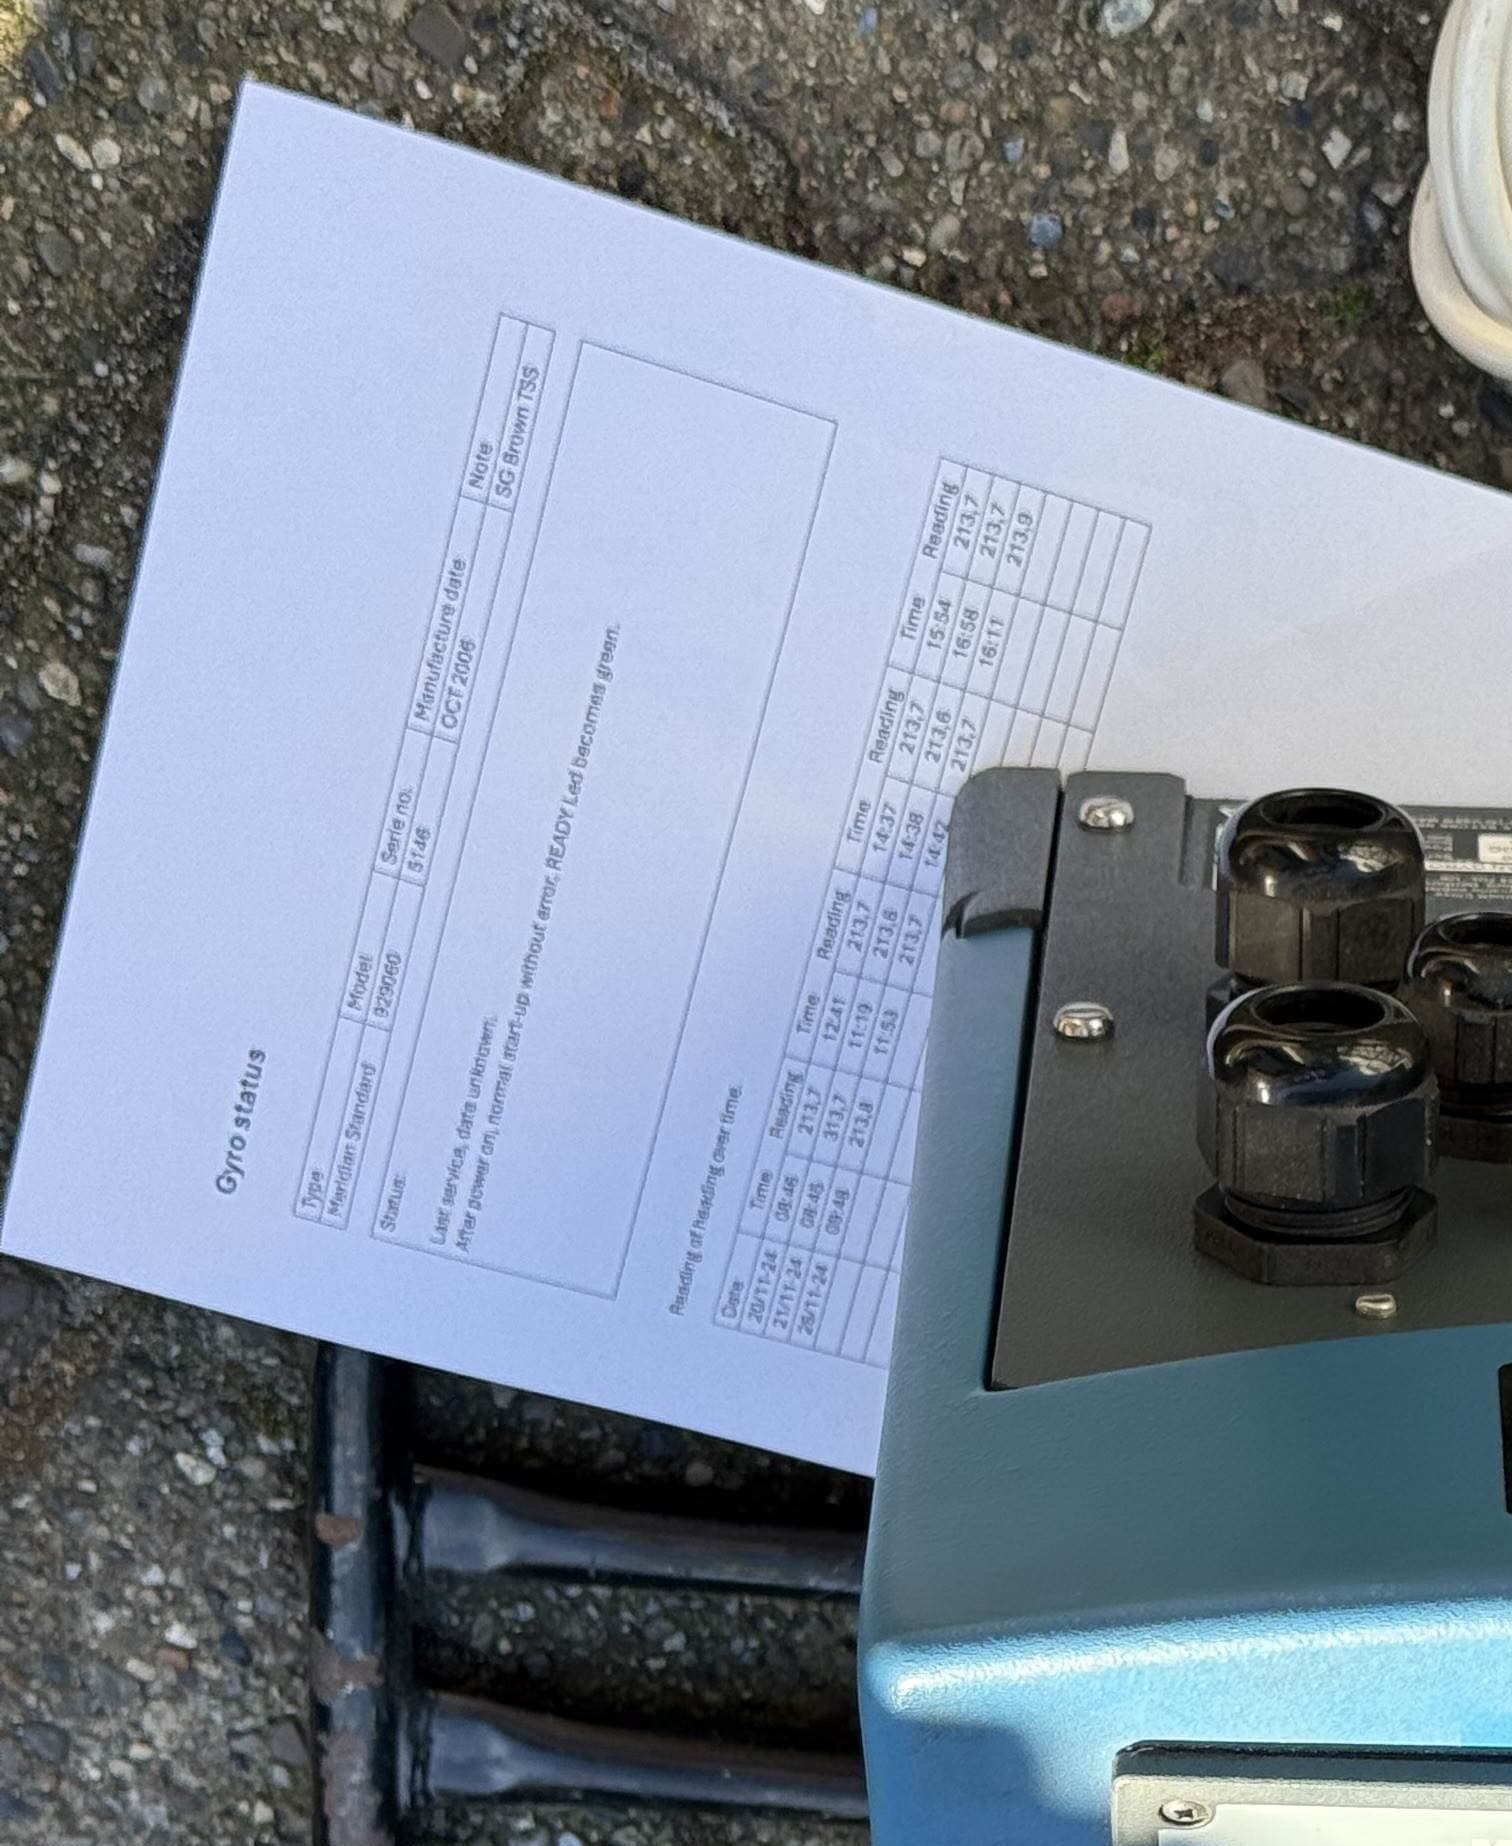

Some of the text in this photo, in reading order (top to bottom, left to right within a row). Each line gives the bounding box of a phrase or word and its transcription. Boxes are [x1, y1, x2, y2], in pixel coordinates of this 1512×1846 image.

[517, 365, 539, 402] TSS
[502, 405, 530, 466] Brown
[494, 468, 515, 498] SG
[979, 502, 1007, 558] 213,7
[451, 638, 476, 686] 2006
[594, 623, 622, 681] green.
[441, 685, 464, 729] OCT
[571, 682, 605, 768] becomes
[846, 900, 871, 951] 213,7
[872, 802, 897, 852] 14:37
[899, 700, 925, 755] 213,7
[953, 494, 981, 549] 213,7
[561, 770, 583, 806] Led
[300, 1168, 325, 1209] Type
[346, 953, 373, 1010] Model
[379, 816, 405, 864] Serie
[414, 603, 455, 721] Manufacture
[442, 557, 466, 601] date
[467, 441, 493, 489] Note
[545, 807, 574, 870] READY
[897, 914, 923, 966] 213,7
[950, 718, 977, 771] 213,7
[721, 480, 959, 1318] Date Time Reading Time Reading Time Reading Time Reading
[373, 951, 402, 1017] 929060
[518, 922, 546, 989] without
[502, 991, 531, 1061] start-up
[214, 1047, 266, 1195] Gyro status
[344, 1062, 376, 1140] Standard
[486, 1064, 512, 1125] normal
[429, 1209, 450, 1245] Last
[440, 1143, 468, 1206] service,
[455, 1100, 477, 1140] date
[711, 1127, 731, 1163] over
[327, 1143, 357, 1216] Meridian
[379, 1173, 406, 1232] Status:
[467, 1157, 490, 1210] power
[692, 1164, 725, 1230] heading
[455, 1211, 477, 1252] After
[687, 1229, 704, 1248] of
[668, 1250, 702, 1316] Reading
